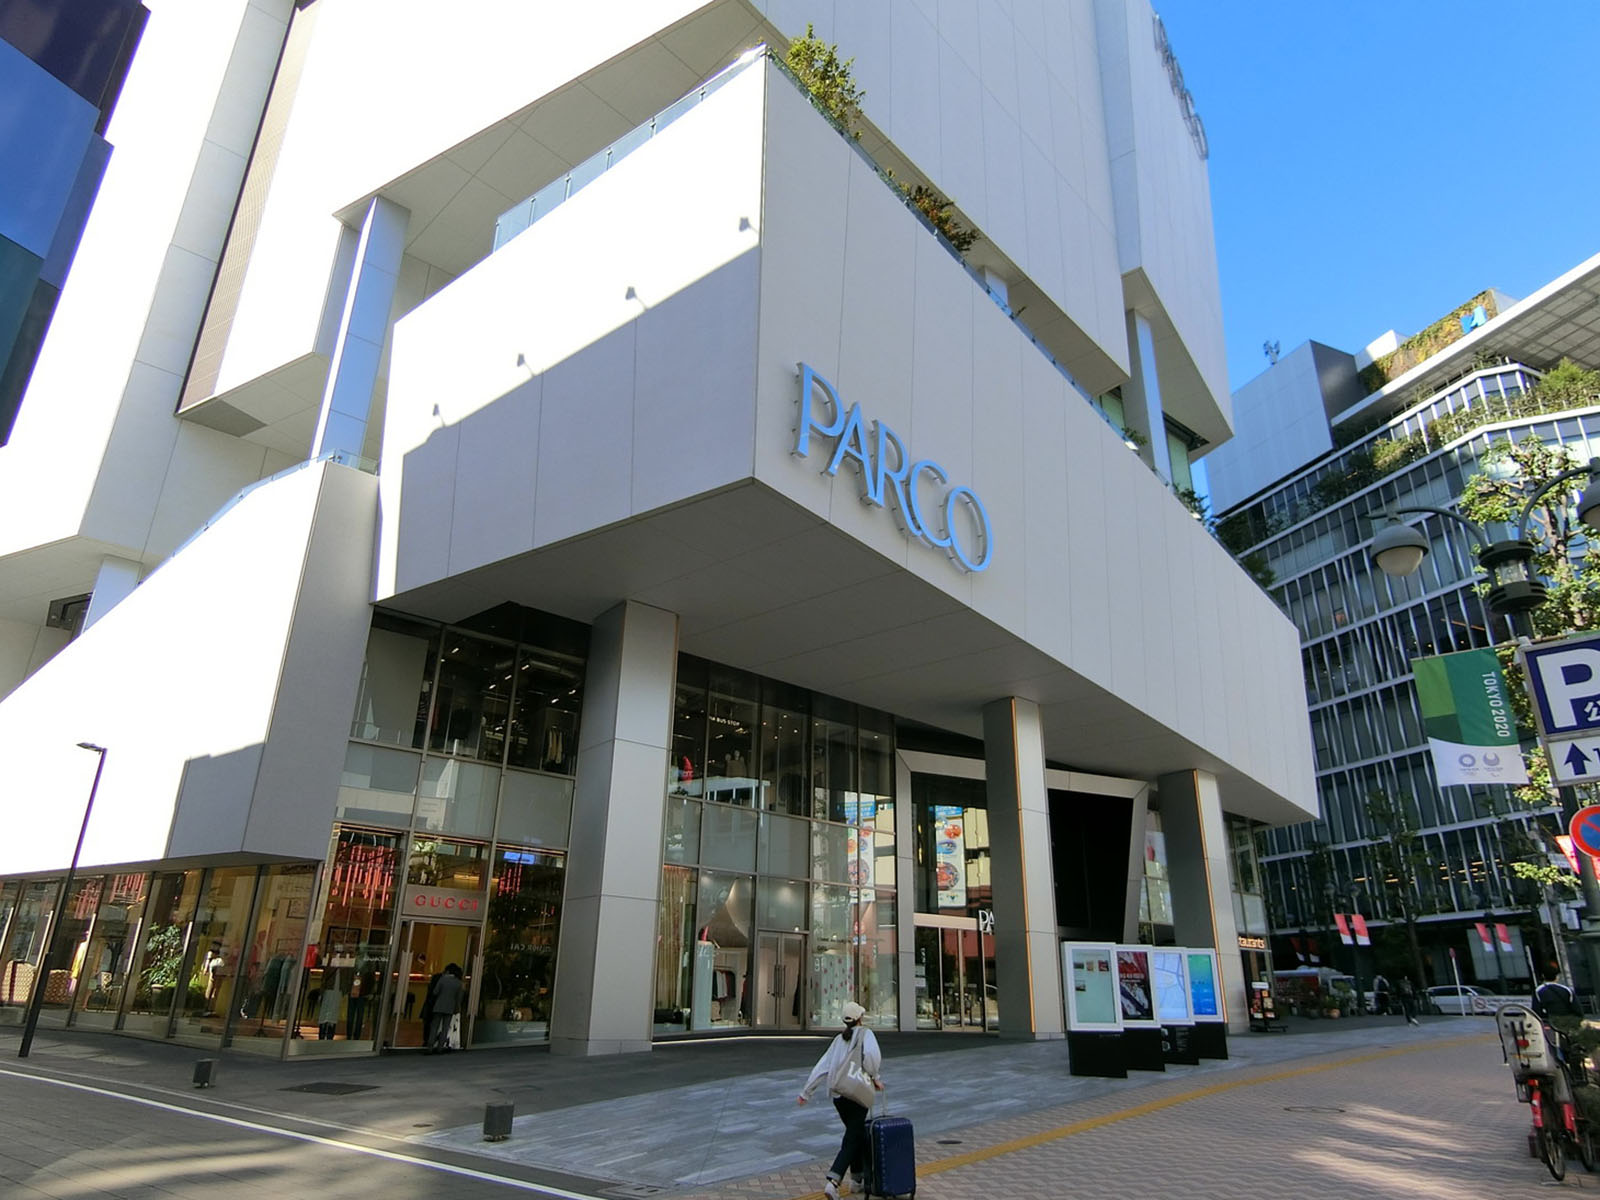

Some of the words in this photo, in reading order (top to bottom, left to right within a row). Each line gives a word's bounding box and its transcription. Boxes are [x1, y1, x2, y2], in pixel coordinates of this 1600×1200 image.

[795, 361, 994, 573] PARCO
[1481, 671, 1503, 708] TOKYO
[1536, 648, 1600, 729] P
[1491, 709, 1511, 737] 2020
[414, 894, 478, 912] GUCCI
